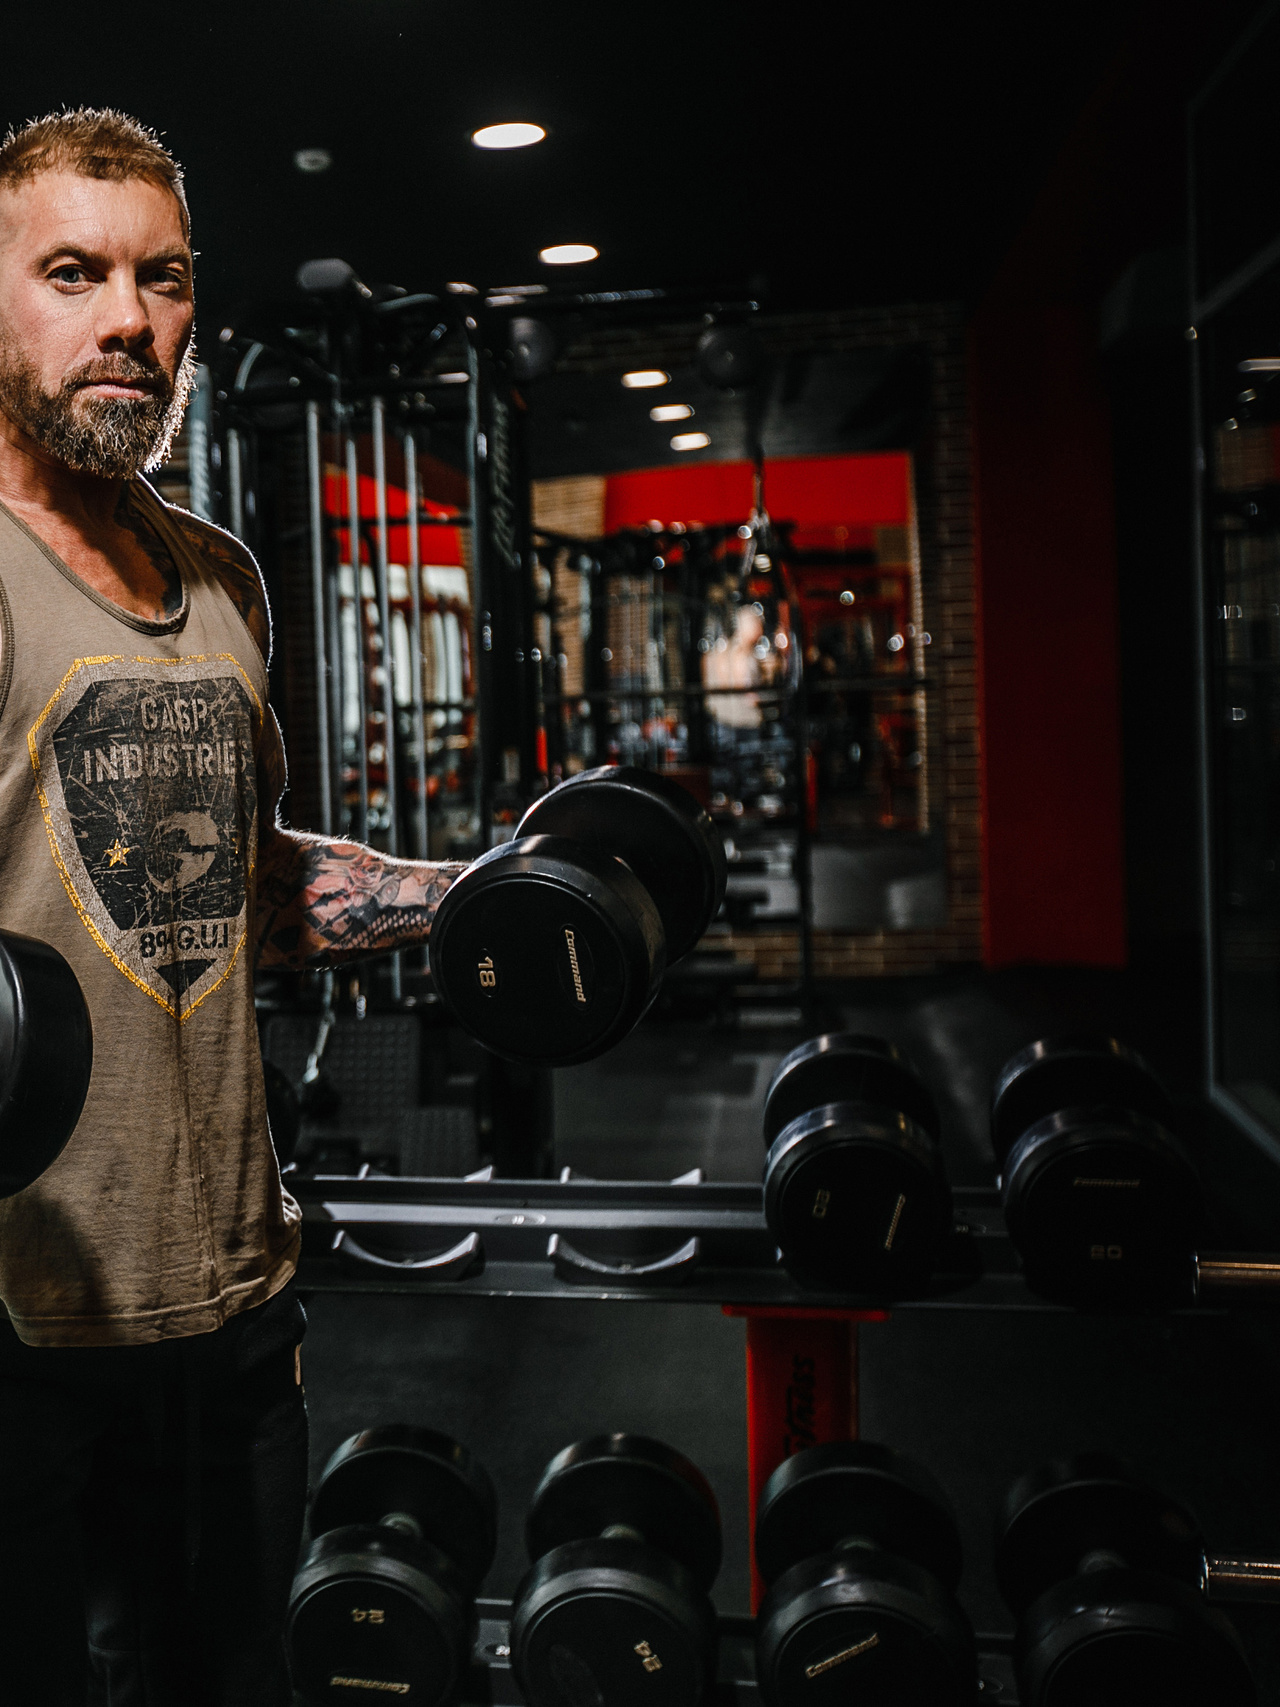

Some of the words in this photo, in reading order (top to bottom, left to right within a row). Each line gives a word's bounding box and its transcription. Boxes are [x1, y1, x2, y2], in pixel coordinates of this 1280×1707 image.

[140, 696, 209, 733] GASP
[477, 956, 497, 988] 18
[564, 929, 587, 1003] Command
[352, 1608, 385, 1625] 24
[330, 1676, 411, 1695] Command
